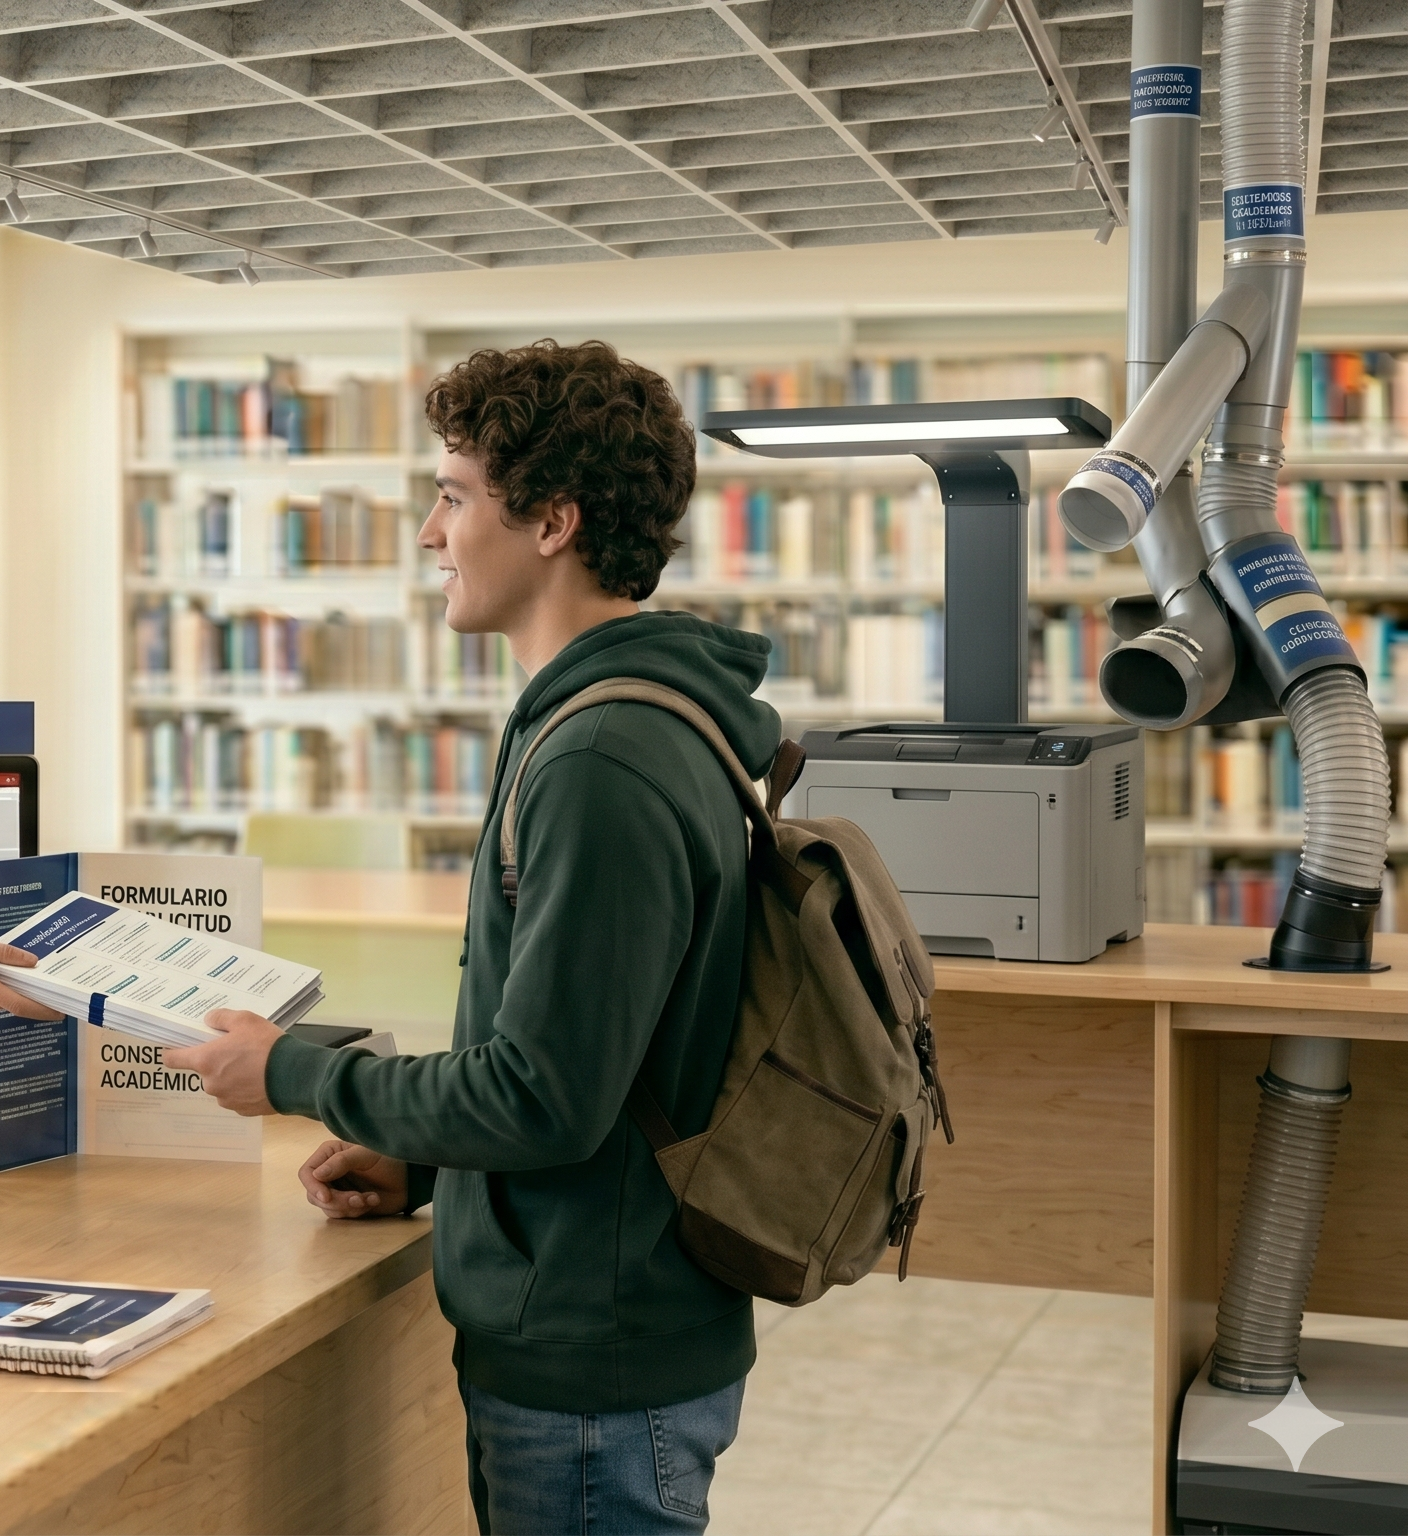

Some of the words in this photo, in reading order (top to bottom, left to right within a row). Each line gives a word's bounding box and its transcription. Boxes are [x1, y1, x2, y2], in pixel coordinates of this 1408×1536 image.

[101, 885, 228, 907] FORMULARIO
[137, 910, 232, 933] ICITUD
[101, 1044, 164, 1065] CONSE
[100, 1067, 205, 1092] ACADÉMIC
